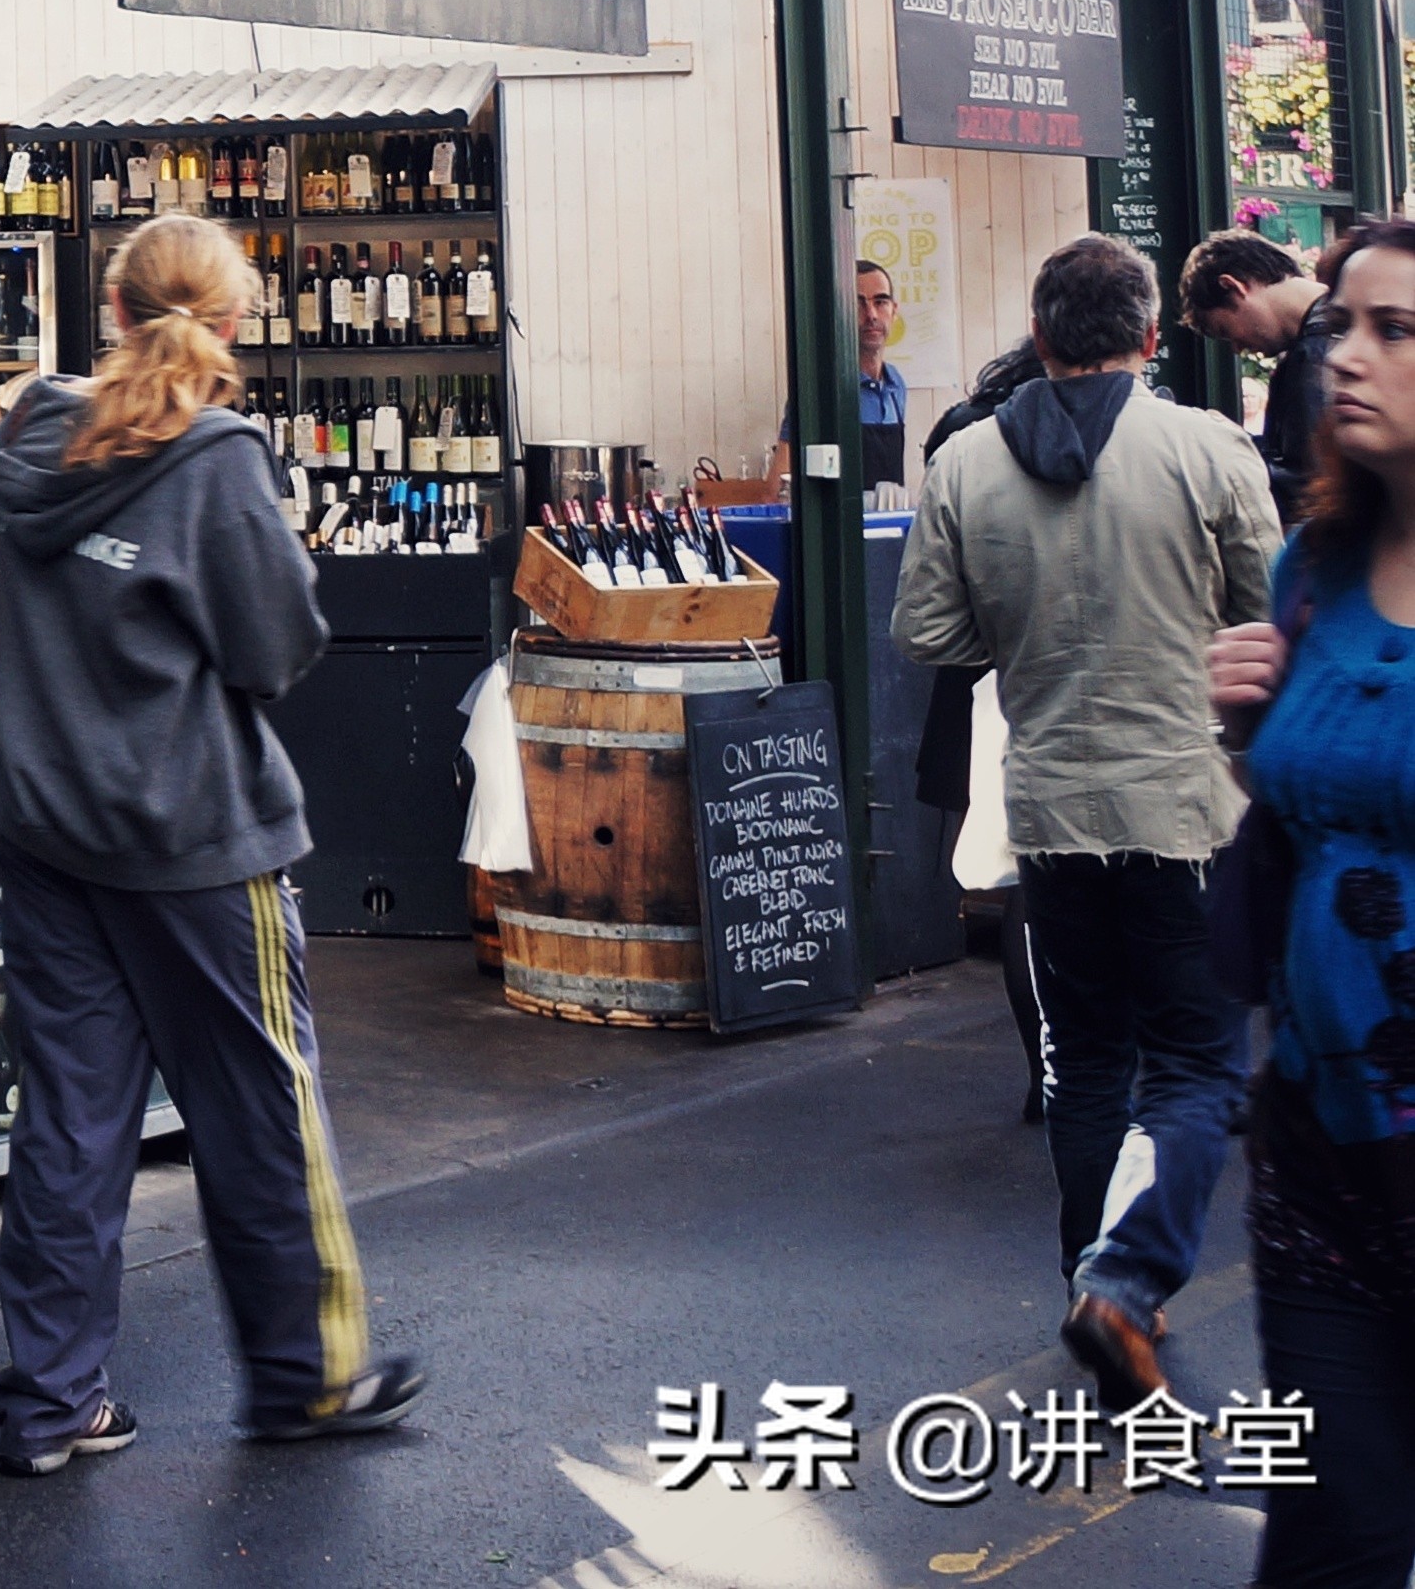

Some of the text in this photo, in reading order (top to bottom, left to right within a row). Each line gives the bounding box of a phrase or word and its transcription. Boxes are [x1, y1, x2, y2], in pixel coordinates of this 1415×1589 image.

[974, 35, 1060, 70] SEE NO EVIL
[970, 70, 1067, 106] HEAR NO EVIL
[1018, 110, 1043, 144] NO
[1046, 113, 1083, 147] EVIL
[722, 729, 828, 774] ON TASTING
[705, 785, 839, 827] DOMAINE HUARDS
[736, 815, 823, 845] BIODYNAMIC
[762, 845, 800, 867] PINOT
[722, 865, 834, 901] CABERNET FRANC
[803, 907, 846, 934] FRESH
